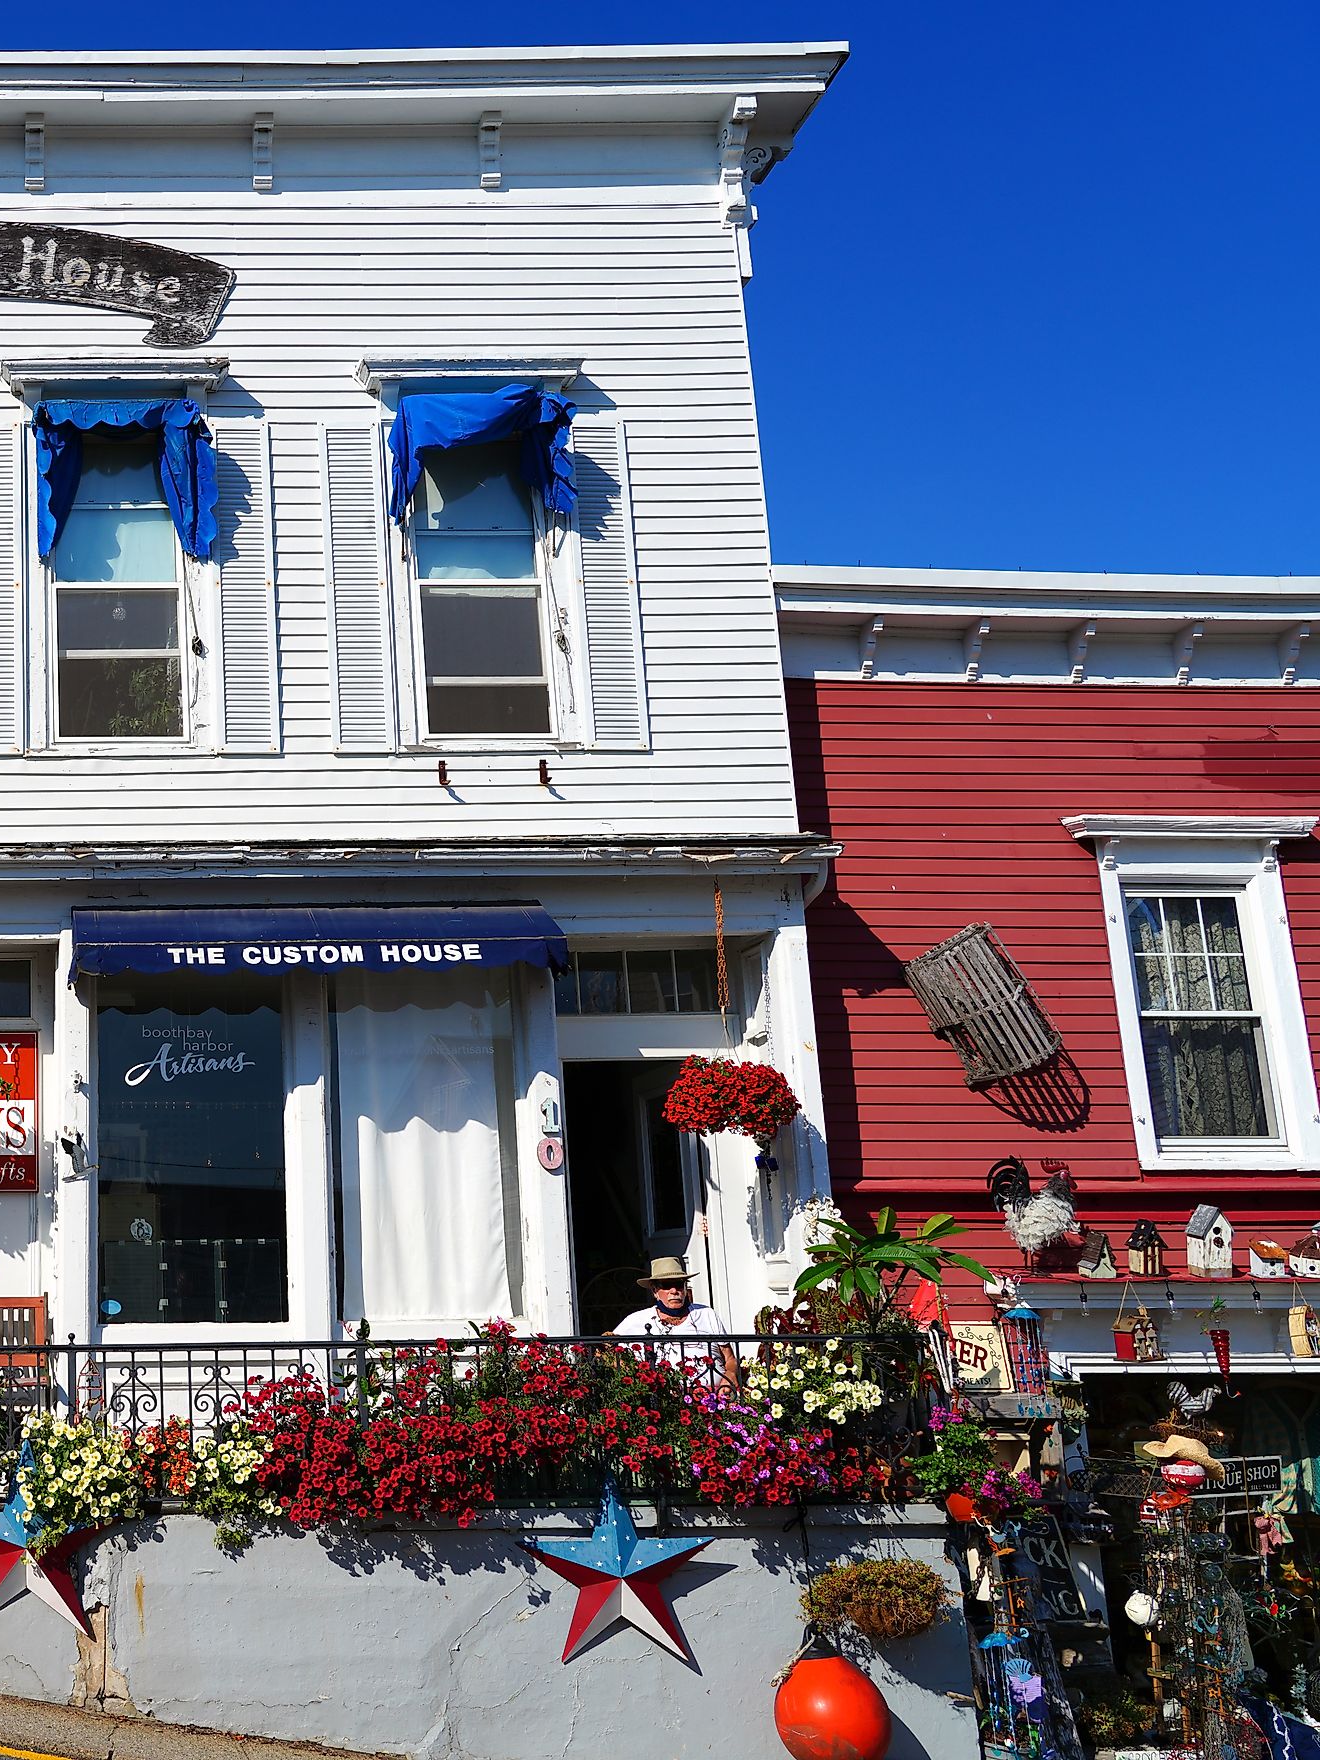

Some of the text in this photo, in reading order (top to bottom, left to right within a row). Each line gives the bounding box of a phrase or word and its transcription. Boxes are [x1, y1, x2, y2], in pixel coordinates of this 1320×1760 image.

[18, 236, 181, 303] House
[167, 943, 483, 965] THE CUSTOM HOUSE
[141, 1025, 213, 1043] boothbay
[182, 1036, 234, 1052] harbor
[124, 1042, 256, 1087] Artisans
[1247, 1464, 1278, 1482] SHOP
